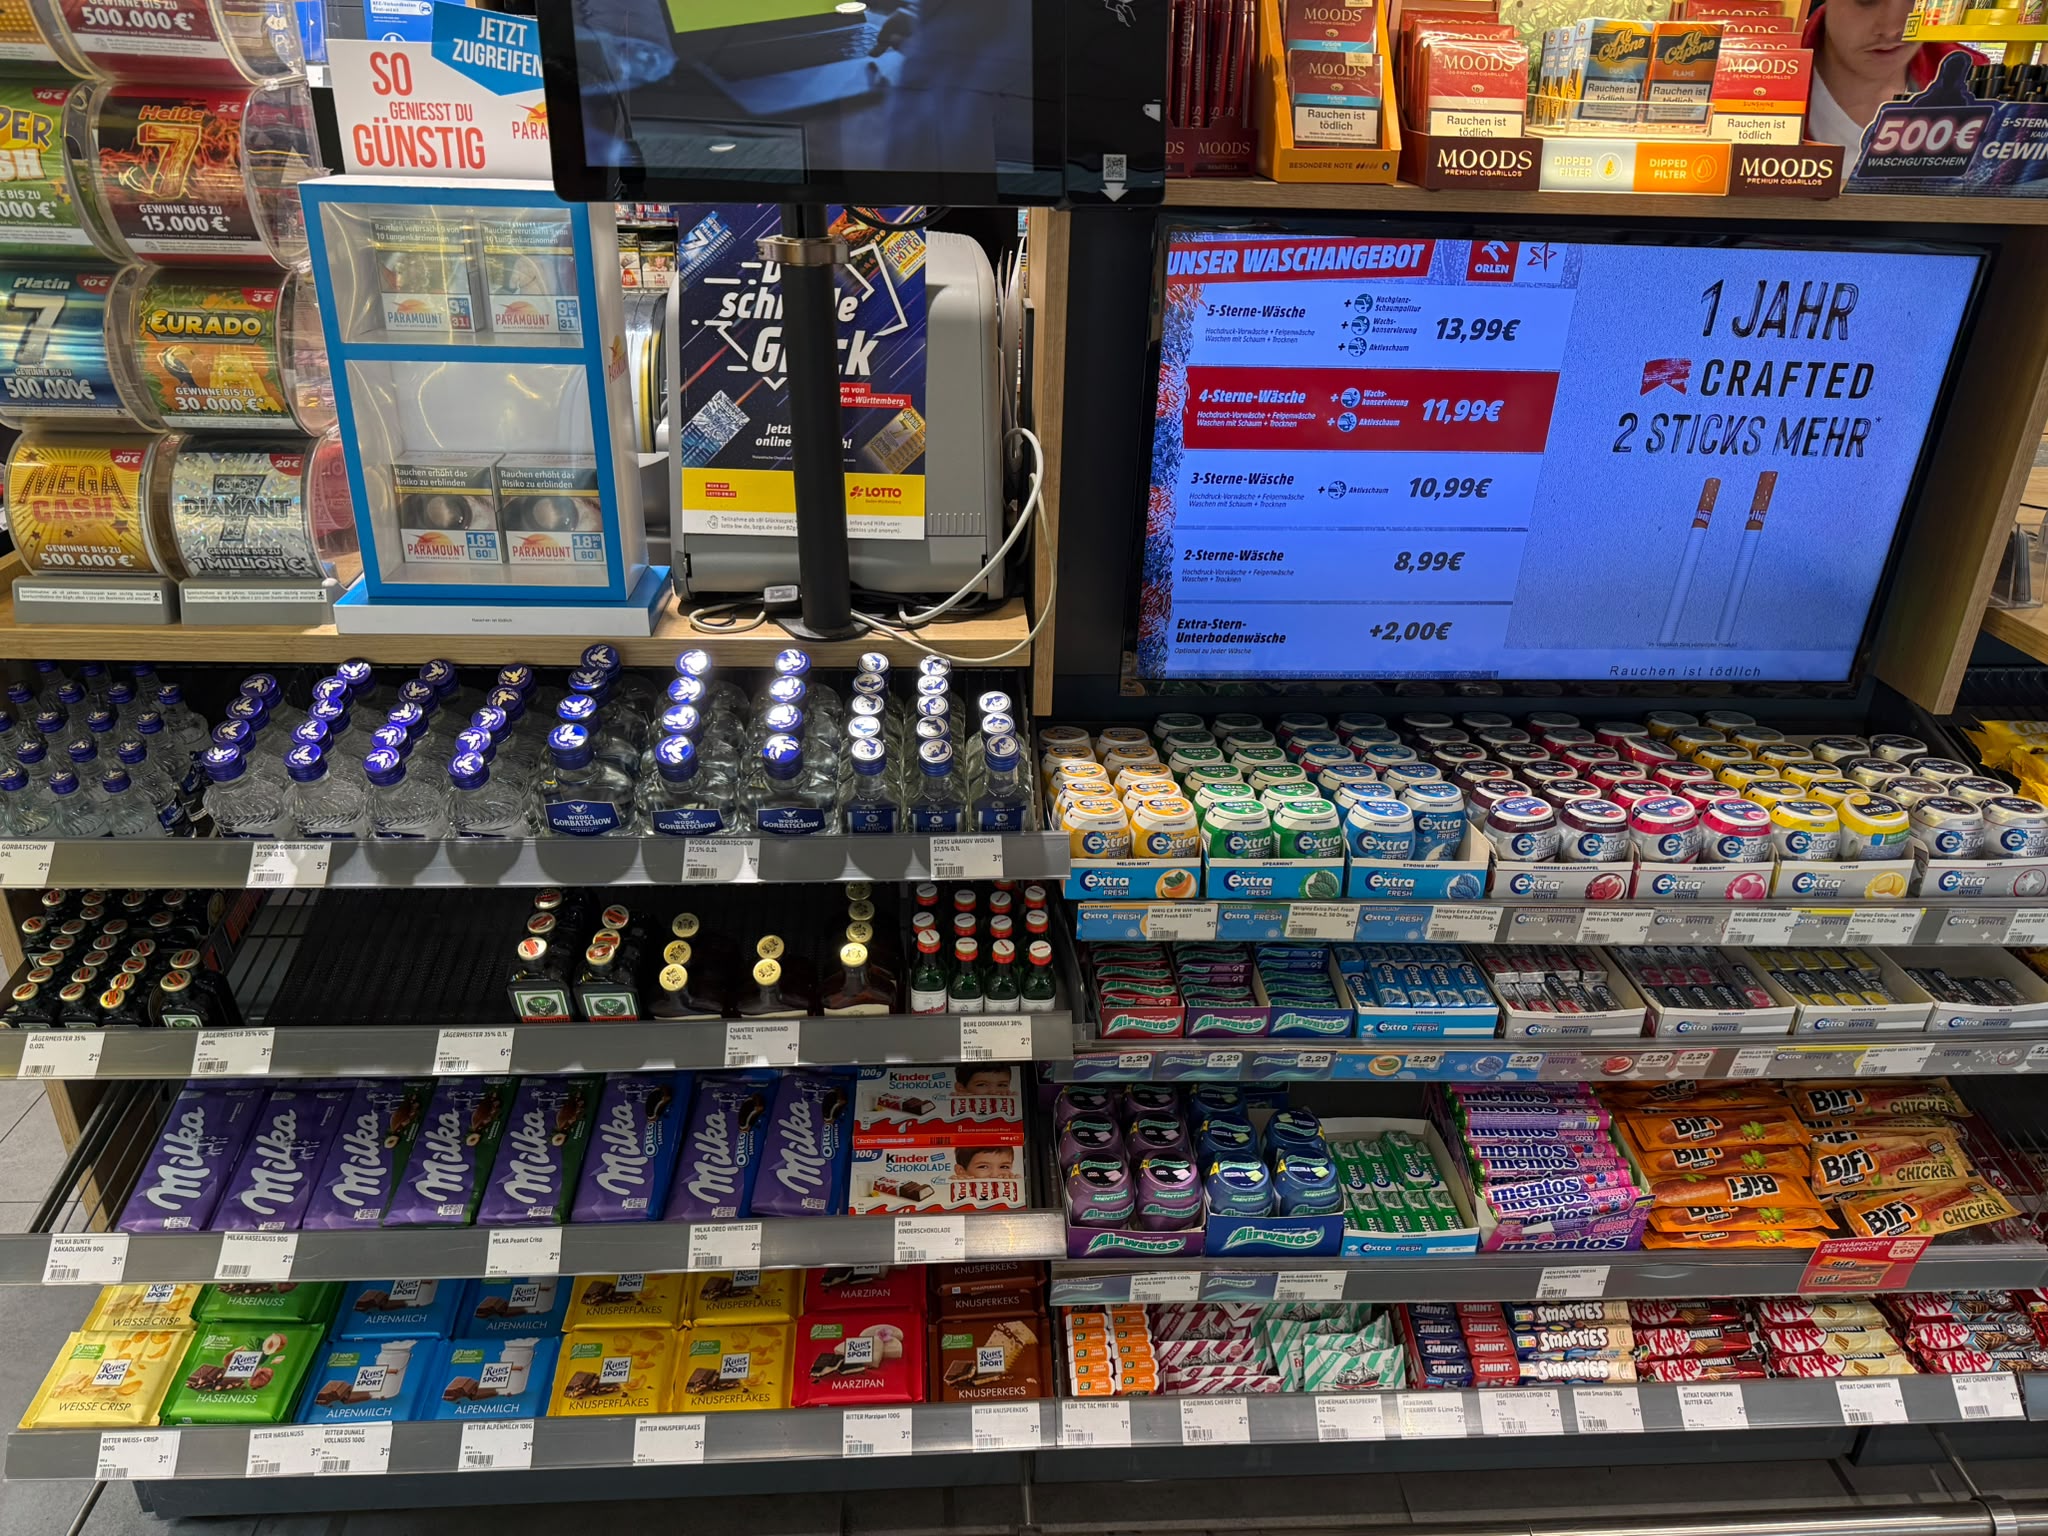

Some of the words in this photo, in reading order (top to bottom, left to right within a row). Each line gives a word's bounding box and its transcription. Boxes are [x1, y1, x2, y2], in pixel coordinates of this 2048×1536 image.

[82, 7, 172, 30] 500.000
[478, 16, 528, 47] JETZT
[452, 38, 543, 78] ZUGREIFEN
[1598, 40, 1648, 64] Capone
[1664, 40, 1716, 66] Capone
[1442, 54, 1514, 72] MOODS
[1727, 58, 1799, 75] MOODS
[370, 52, 413, 96] SO
[1652, 86, 1688, 100] Rauchen
[1691, 86, 1707, 98] ist
[138, 106, 204, 122] Heiße
[389, 102, 451, 121] GENIESST
[455, 104, 473, 122] DU
[1307, 109, 1350, 121] Rauchen
[1352, 109, 1366, 120] ist
[1319, 119, 1353, 131] tödlich
[1446, 115, 1489, 128] Rauchen
[1492, 116, 1506, 126] ist
[512, 121, 548, 140] PARA
[1459, 126, 1493, 137] tödlich
[1738, 129, 1772, 141] tödlich
[1873, 117, 1984, 151] 500€
[352, 117, 486, 170] GÜNSTIG
[137, 122, 202, 200] 7
[1289, 161, 1329, 169] BESONDERE
[1332, 162, 1353, 170] NOTE
[1437, 149, 1533, 170] MOODS
[1554, 157, 1593, 167] DIPPED
[1649, 158, 1688, 168] DIPPED
[1867, 156, 1968, 168] WASCHGUTSCHEIN
[1559, 168, 1592, 179] FILTER
[1654, 170, 1687, 180] FILTER
[1740, 159, 1834, 179] MOODS
[1746, 177, 1778, 186] PREMIUM
[1781, 178, 1822, 186] CIGARILLOS
[139, 203, 186, 215] GEWINNE
[188, 206, 207, 215] BIS
[209, 206, 223, 215] ZU
[142, 215, 209, 232] 15.000
[1167, 249, 1238, 276] UNSER
[1242, 243, 1425, 274] WASCHANGEBOT
[1474, 264, 1509, 274] ORLEN
[13, 277, 70, 290] Platin
[387, 310, 443, 325] PARAMOUNT
[1207, 305, 1306, 319] 5-Sterne-Wäsche
[1701, 279, 1725, 338] 1
[1731, 280, 1859, 341] JAHR
[10, 292, 65, 366] 7
[1436, 318, 1520, 342] 13,99€
[1700, 359, 1874, 400] CRAFTED
[4, 378, 95, 400] 500.000€
[176, 387, 222, 396] GEWINNE
[224, 387, 240, 396] BIS
[242, 388, 255, 397] ZU
[851, 386, 865, 394] von
[175, 397, 243, 412] 30.000
[1199, 390, 1306, 404] 4-Sterne-Wäsche
[1422, 399, 1504, 422] 11,99€
[1612, 412, 1638, 453] 2
[1646, 412, 1766, 456] STICKS
[756, 437, 792, 448] online
[394, 467, 427, 478] Rauchen
[428, 468, 453, 478] erhöht
[454, 470, 468, 478] das
[1191, 473, 1294, 486] 3-Sterne-Wäsche
[20, 465, 129, 509] MEGA
[502, 479, 524, 489] Risiko
[526, 481, 535, 489] zu
[537, 480, 573, 489] erblinden
[1409, 477, 1492, 500] 10,99€
[865, 486, 902, 498] LOTTO
[32, 496, 114, 524] CASH
[184, 498, 291, 517] DIAMANT
[407, 543, 464, 558] PARAMOUNT
[512, 544, 570, 560] PARAMOUNT
[1183, 549, 1284, 562] 2-Sterne-Wäsche
[40, 553, 116, 567] 500.000
[1394, 551, 1464, 573] 8,99€
[1176, 618, 1247, 630] Extra-Stern-
[1370, 622, 1452, 641] +2,00€
[1176, 631, 1286, 644] Unterbodenwäsche
[1609, 666, 1676, 676] Rauchen
[1683, 666, 1700, 677] ist
[1708, 666, 1760, 677] tödlich
[552, 817, 612, 828] GORBATSCHOW
[566, 814, 593, 826] WODKA
[1087, 830, 1129, 852] extra
[1156, 830, 1198, 852] extra
[1299, 830, 1341, 852] extra
[1437, 830, 1460, 839] FRESH
[1961, 887, 1984, 896] WHITE
[1274, 1013, 1353, 1034] Airwaves
[1378, 1021, 1409, 1032] extra
[1215, 1053, 1240, 1065] 2,29
[641, 1120, 659, 1157] OREO
[146, 1106, 210, 1210] Milka
[241, 1109, 302, 1214] Milka
[332, 1110, 386, 1207] Milka
[854, 1150, 878, 1161] 100g
[886, 1161, 951, 1174] SCHOKOLADE
[1821, 1147, 1875, 1182] BiFi
[1896, 1162, 1957, 1181] CHICKEN
[1491, 1176, 1581, 1201] mentos
[1943, 1201, 2007, 1225] CHICKEN
[1082, 1232, 1187, 1256] Airwaves
[1221, 1225, 1326, 1250] Airwaves
[1502, 1233, 1628, 1252] mentos
[1823, 1240, 1888, 1252] SCHNÄPPCHEN
[1840, 1245, 1879, 1253] MONATS
[1648, 1329, 1689, 1357] KitKat
[1775, 1327, 1826, 1353] KitKat
[95, 1372, 123, 1382] SPORT
[479, 1374, 506, 1384] SPORT
[832, 1378, 884, 1390] MARZIPAN
[195, 1392, 258, 1405] HASELNUSS
[958, 1386, 1026, 1398] KNUSPERKEKS
[58, 1401, 96, 1413] WEISSE
[100, 1401, 131, 1413] CRISP
[568, 1397, 648, 1411] KNUSPERFLAKES
[326, 1406, 392, 1420] ALPENMILCH
